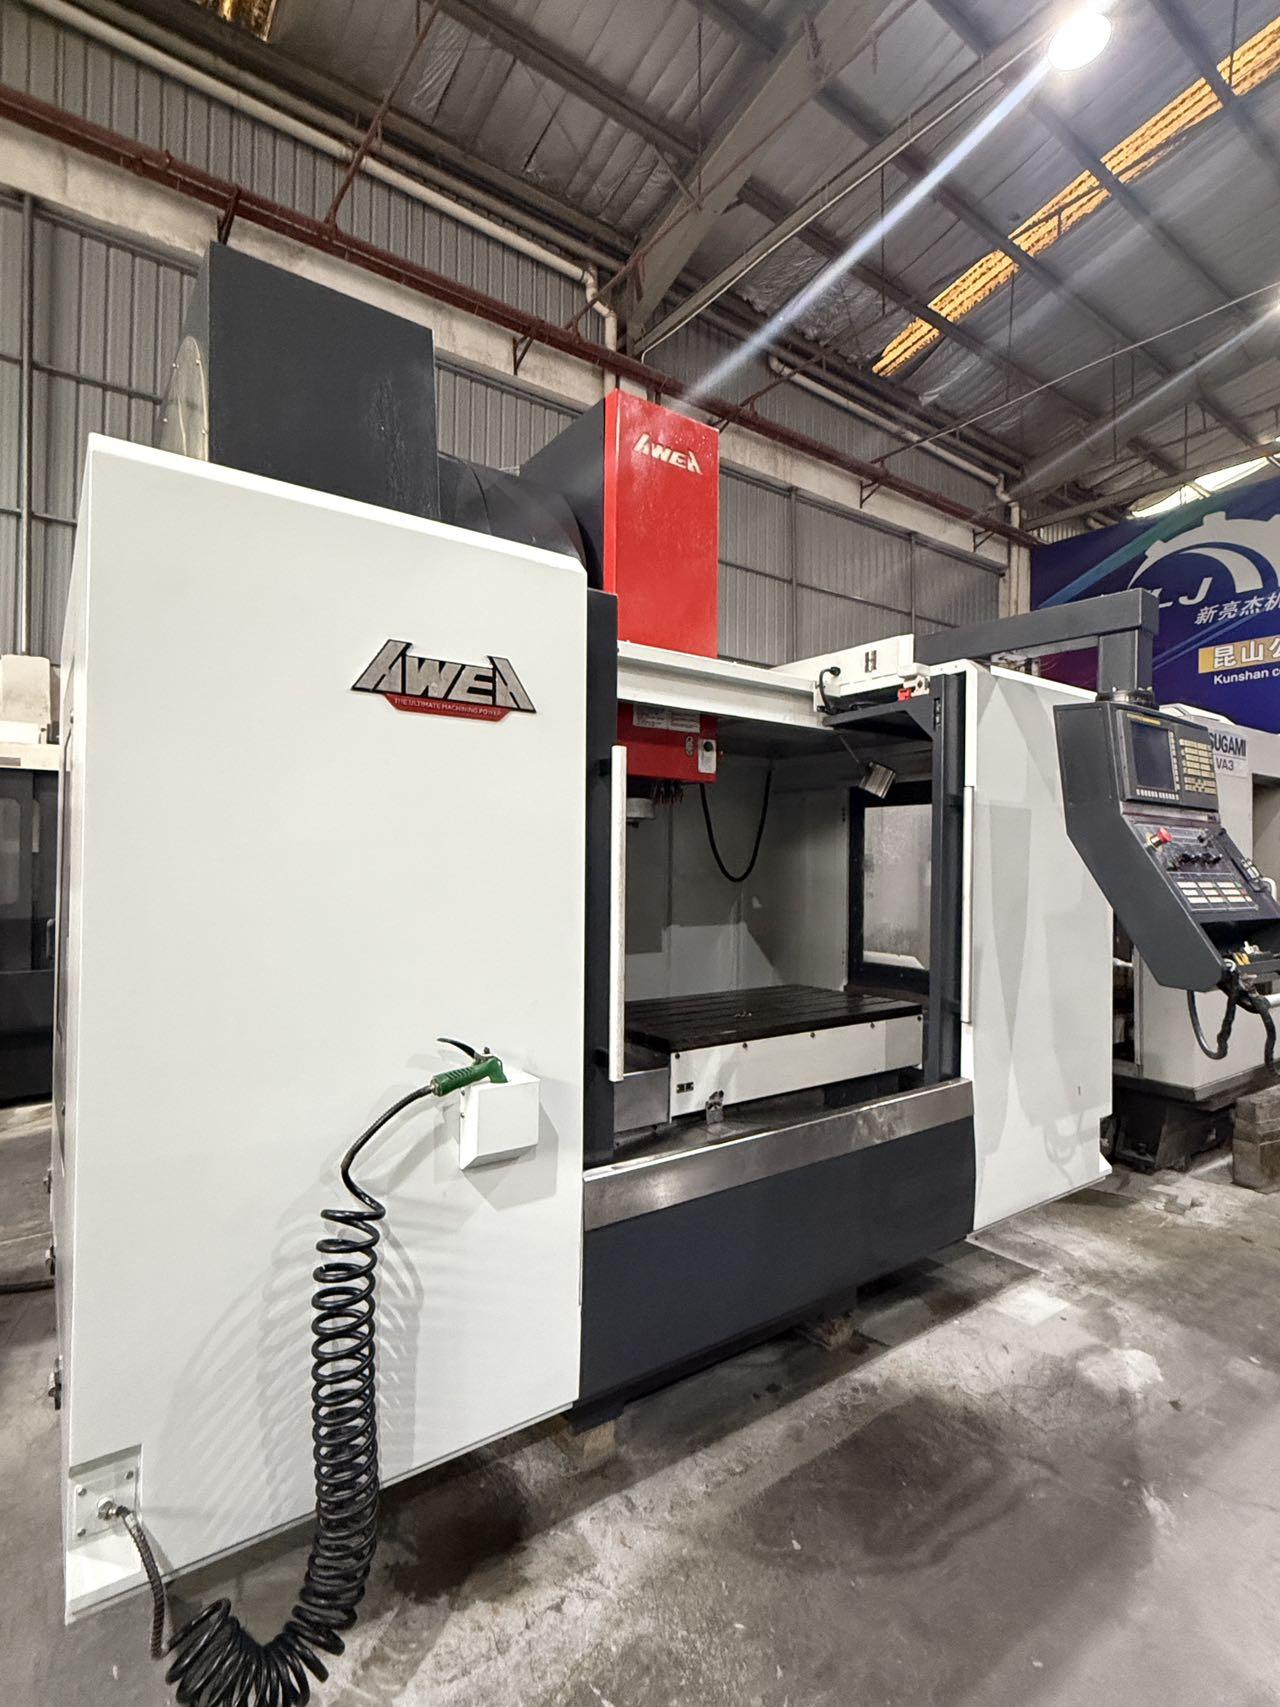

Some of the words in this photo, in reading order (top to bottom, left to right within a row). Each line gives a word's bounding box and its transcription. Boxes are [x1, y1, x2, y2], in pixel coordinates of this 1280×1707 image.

[633, 432, 703, 475] AWEA
[350, 638, 537, 714] AWEA
[1213, 669, 1269, 685] Kunshan
[1271, 667, 1280, 678] c
